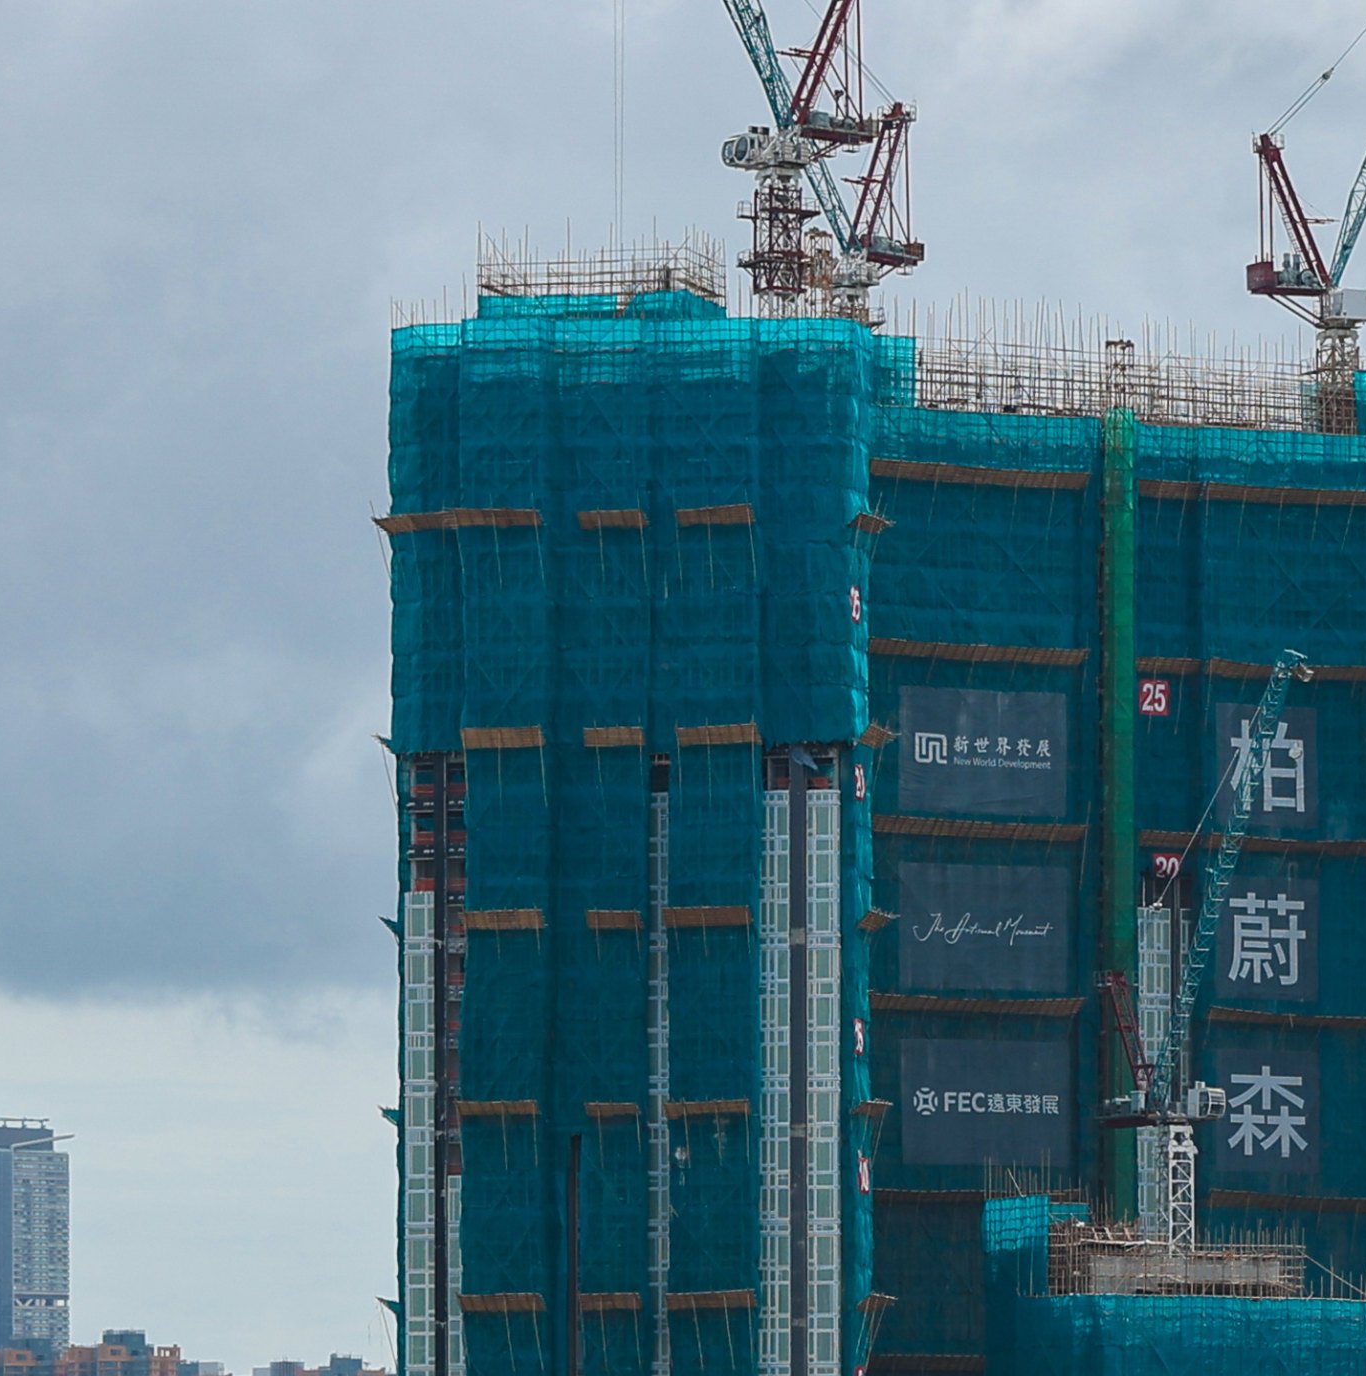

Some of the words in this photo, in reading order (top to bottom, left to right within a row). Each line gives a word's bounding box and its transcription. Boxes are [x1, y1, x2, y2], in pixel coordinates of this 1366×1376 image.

[1141, 682, 1167, 713] 25
[953, 735, 1052, 757] 新世界發展
[953, 756, 971, 766] New
[973, 757, 997, 767] World
[998, 759, 1052, 770] Development
[1230, 719, 1305, 813] 柏
[1155, 857, 1180, 879] 20
[912, 912, 944, 942] The
[1228, 892, 1306, 986] 蔚
[943, 1091, 985, 1113] FEC
[987, 1093, 1060, 1115] 遠東發展
[1227, 1065, 1308, 1158] 森
